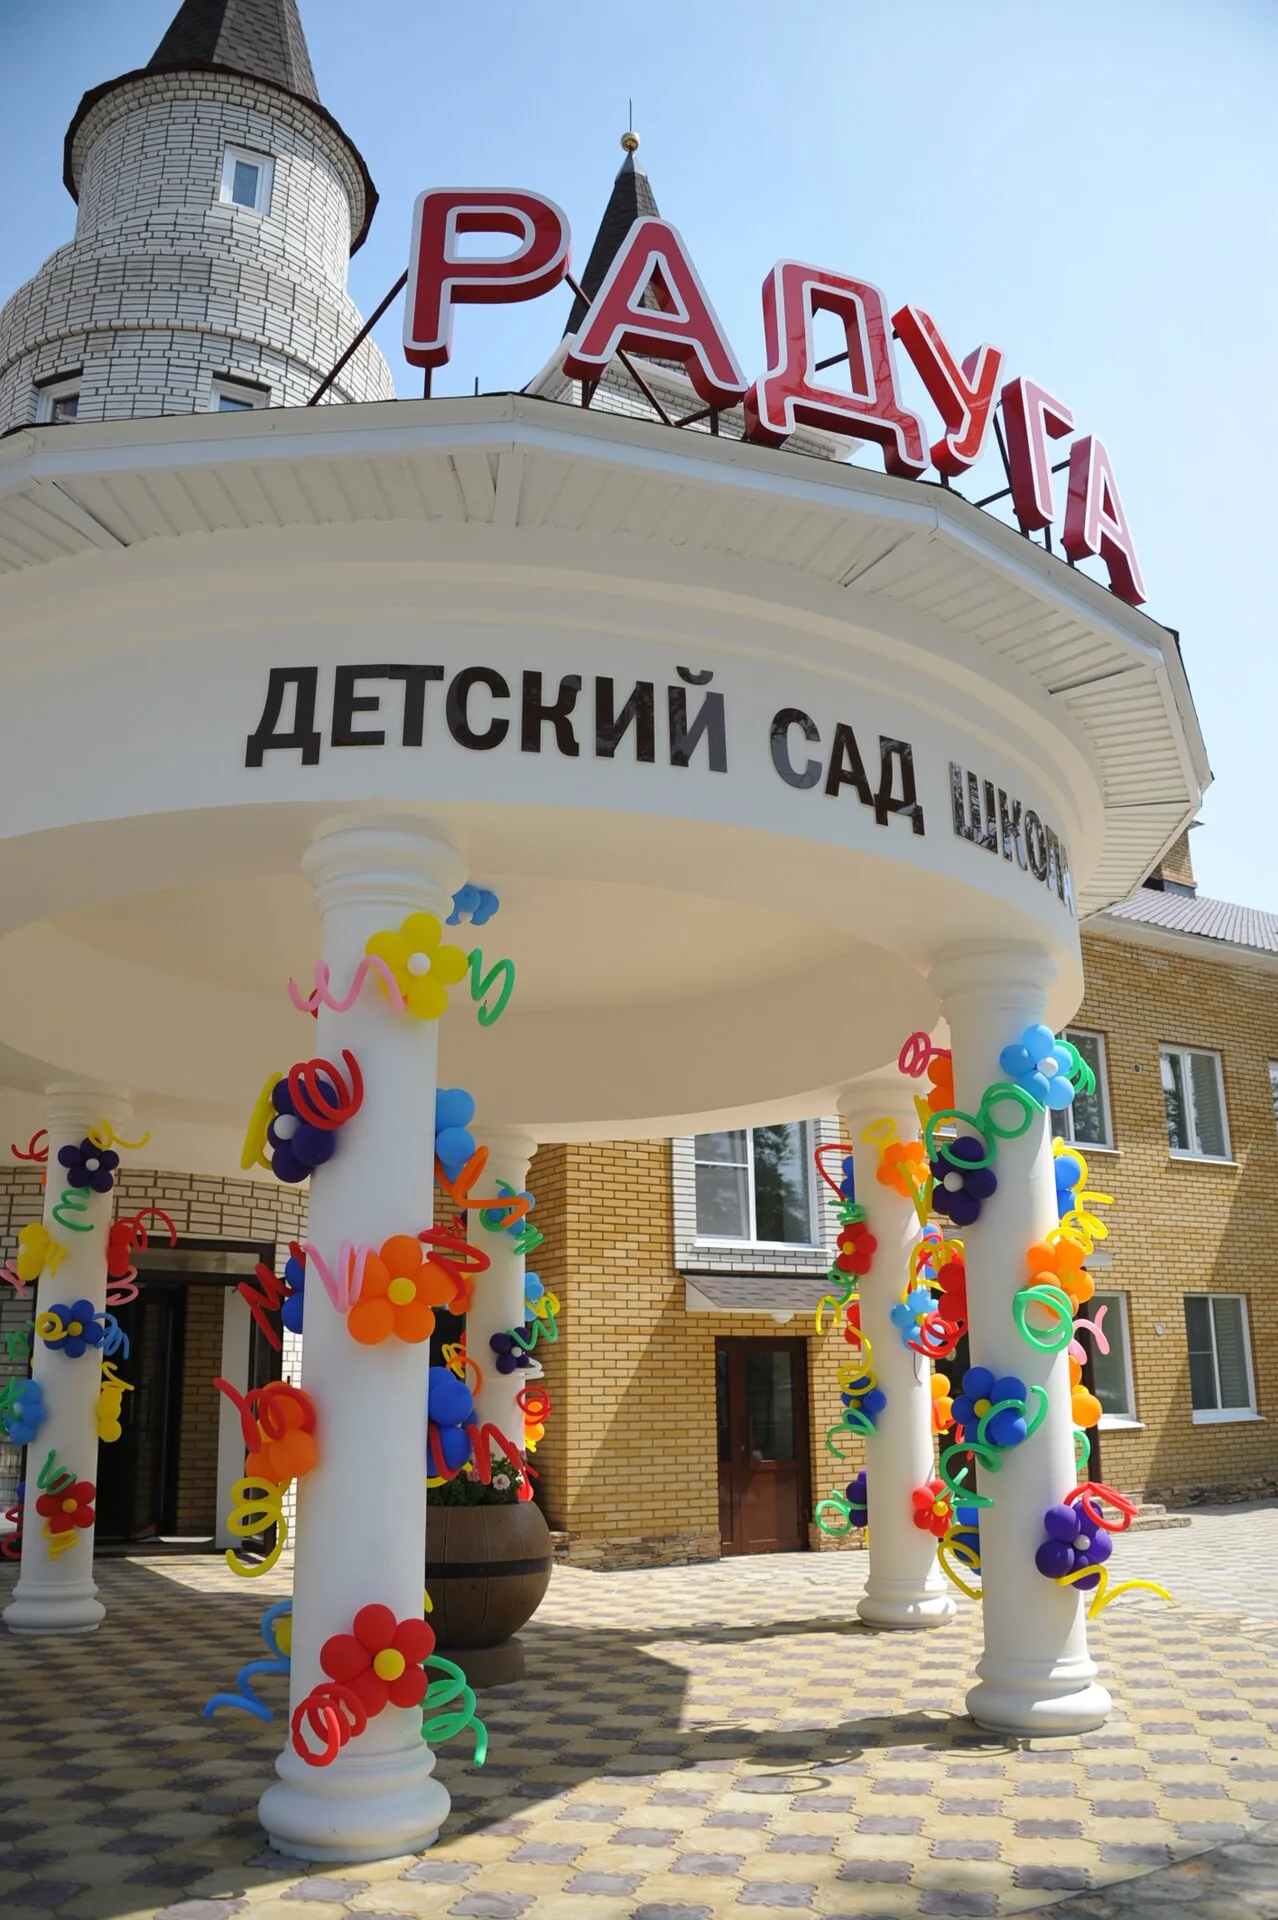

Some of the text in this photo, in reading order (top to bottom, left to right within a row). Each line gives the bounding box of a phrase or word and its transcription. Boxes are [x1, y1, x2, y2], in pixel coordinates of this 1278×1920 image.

[402, 186, 1147, 606] РАДУГА
[245, 663, 728, 773] ДЕТСКИЙ
[770, 707, 925, 836] САД
